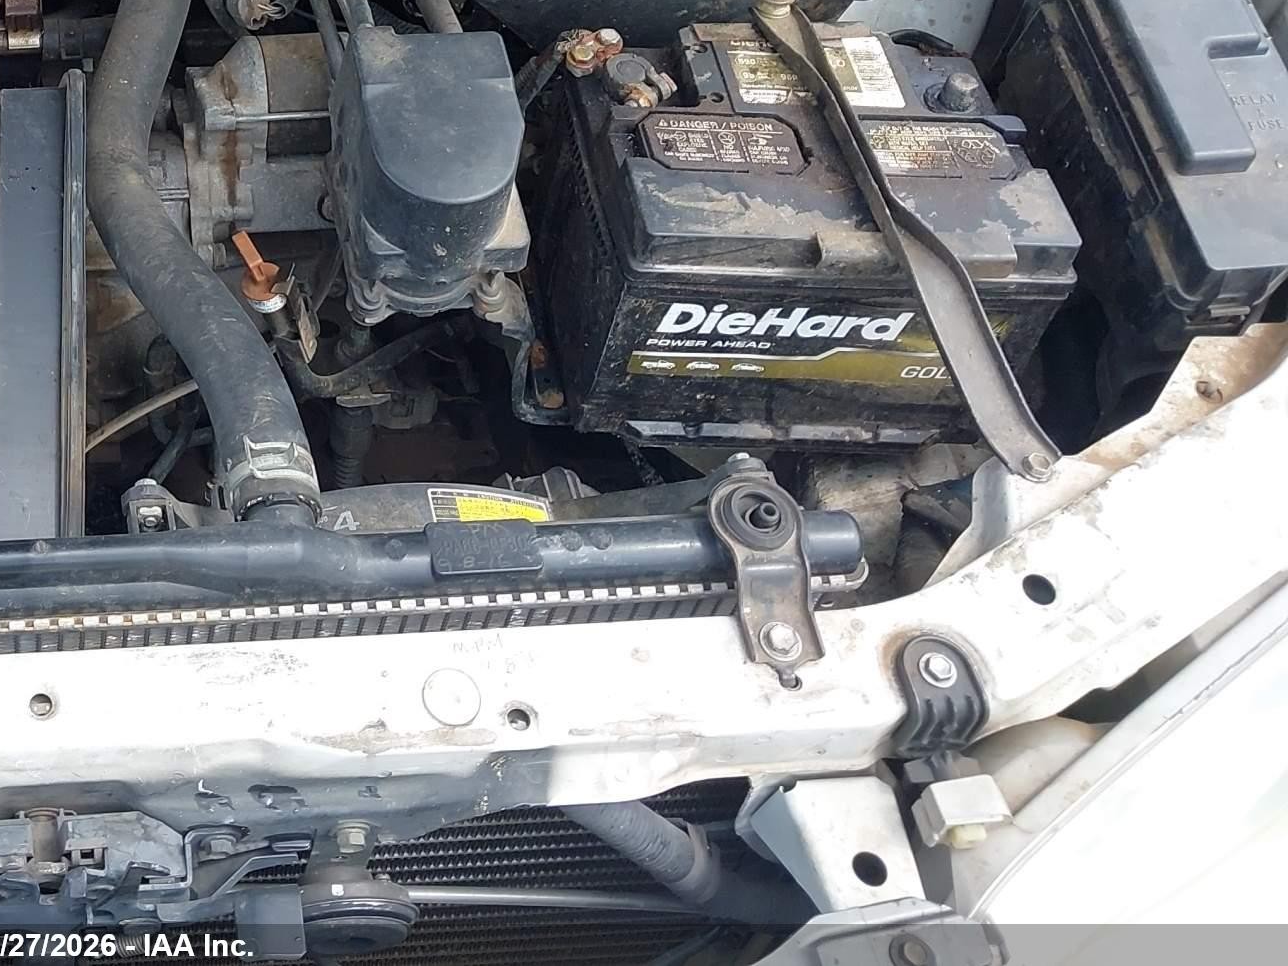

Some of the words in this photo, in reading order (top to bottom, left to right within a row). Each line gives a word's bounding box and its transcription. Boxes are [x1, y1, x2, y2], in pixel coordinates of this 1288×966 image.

[1231, 94, 1276, 106] RELAY
[669, 120, 719, 130] DANGER
[730, 121, 773, 131] POISON
[1247, 120, 1284, 131] FUSE
[655, 302, 914, 341] DieHard
[646, 338, 708, 348] POWER
[711, 339, 772, 350] AHEAD
[900, 365, 952, 379] GOL
